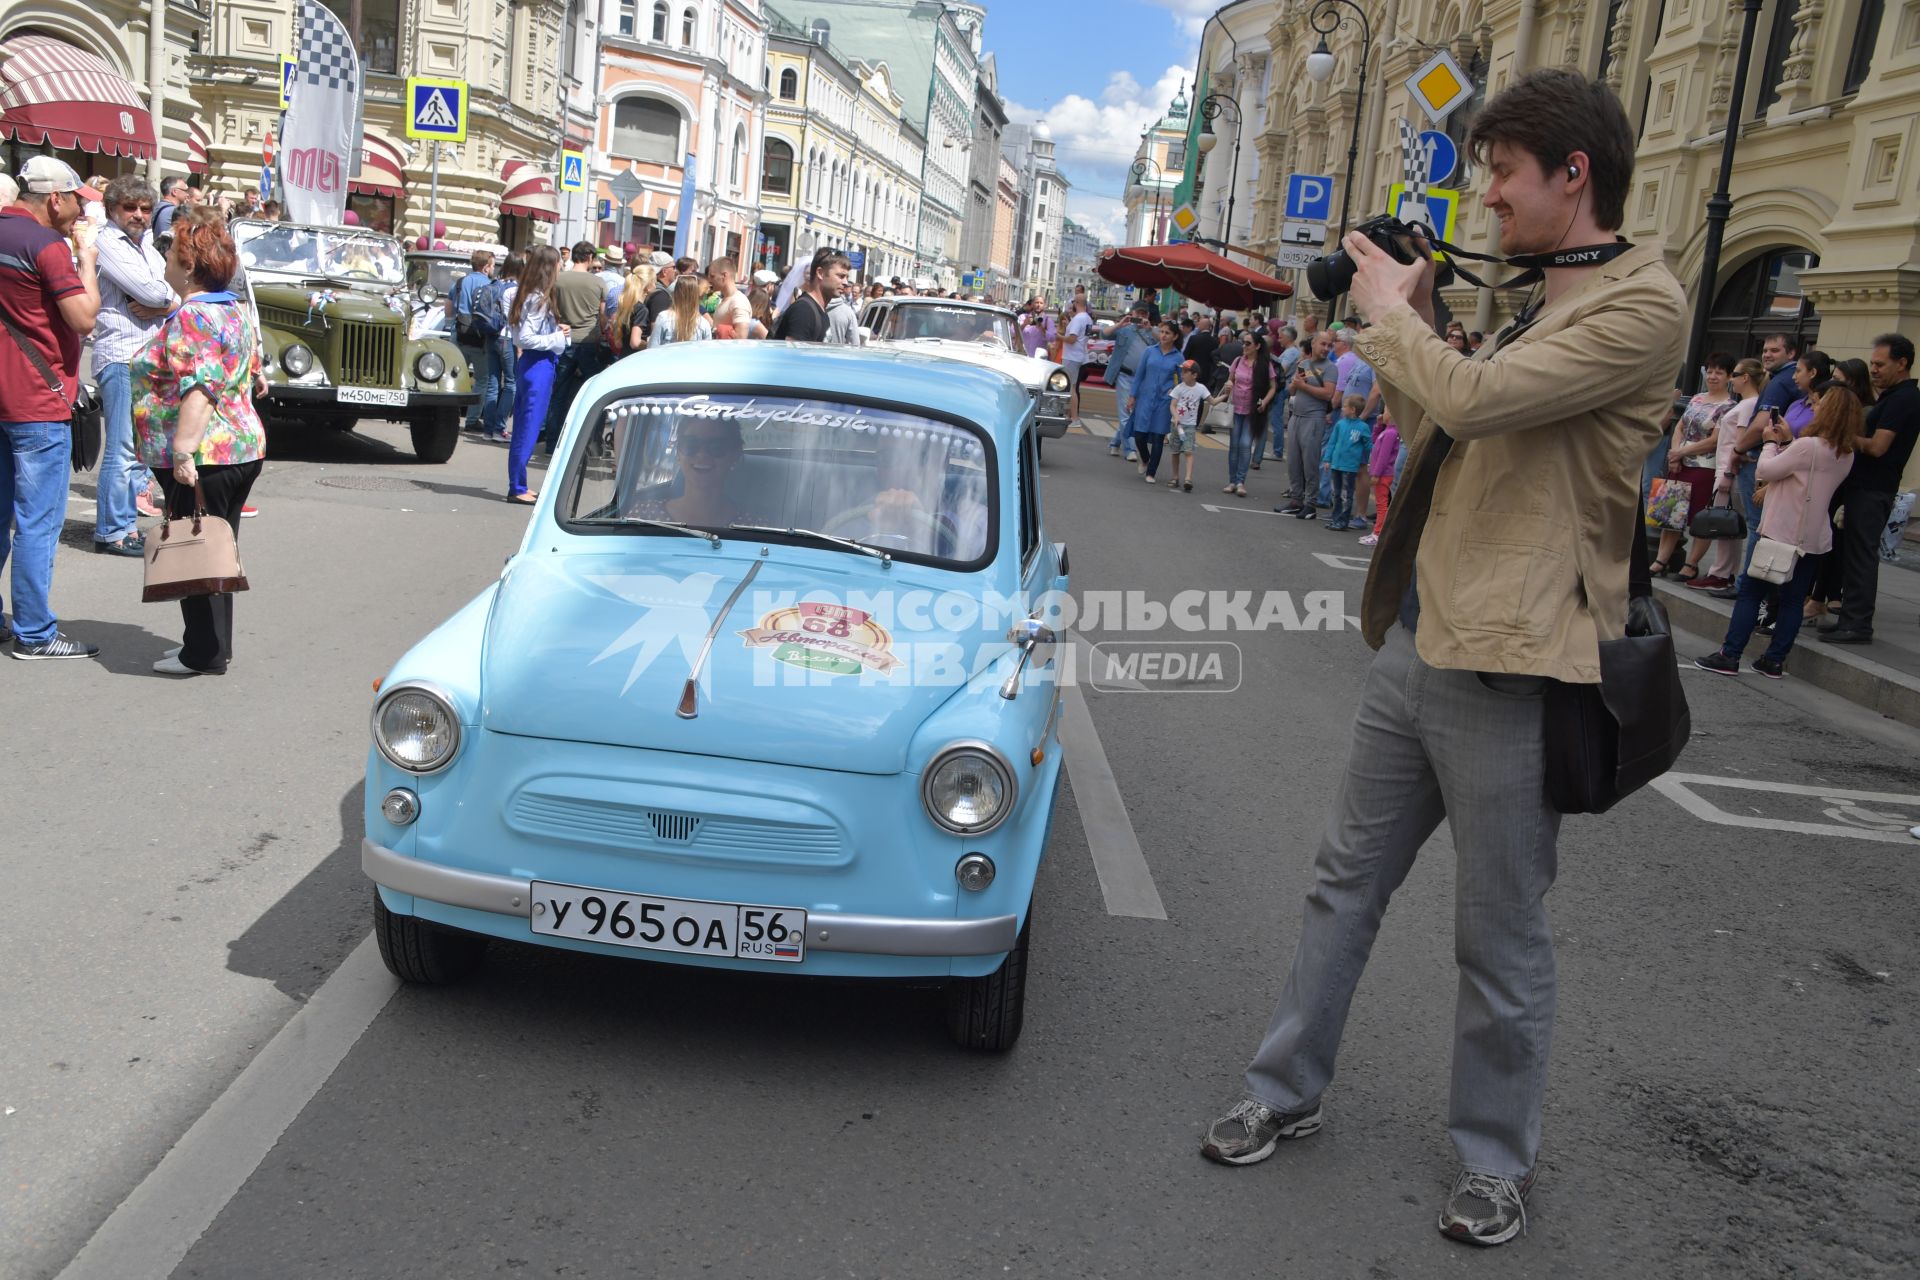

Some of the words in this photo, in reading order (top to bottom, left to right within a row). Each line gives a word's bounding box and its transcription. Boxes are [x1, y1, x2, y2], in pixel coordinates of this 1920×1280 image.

[1297, 179, 1324, 214] P
[1555, 250, 1601, 264] SONY
[388, 391, 405, 401] 750
[676, 394, 870, 431] Gorkyclassic
[802, 617, 851, 638] 68
[743, 911, 788, 942] 56
[741, 942, 774, 955] RUS
